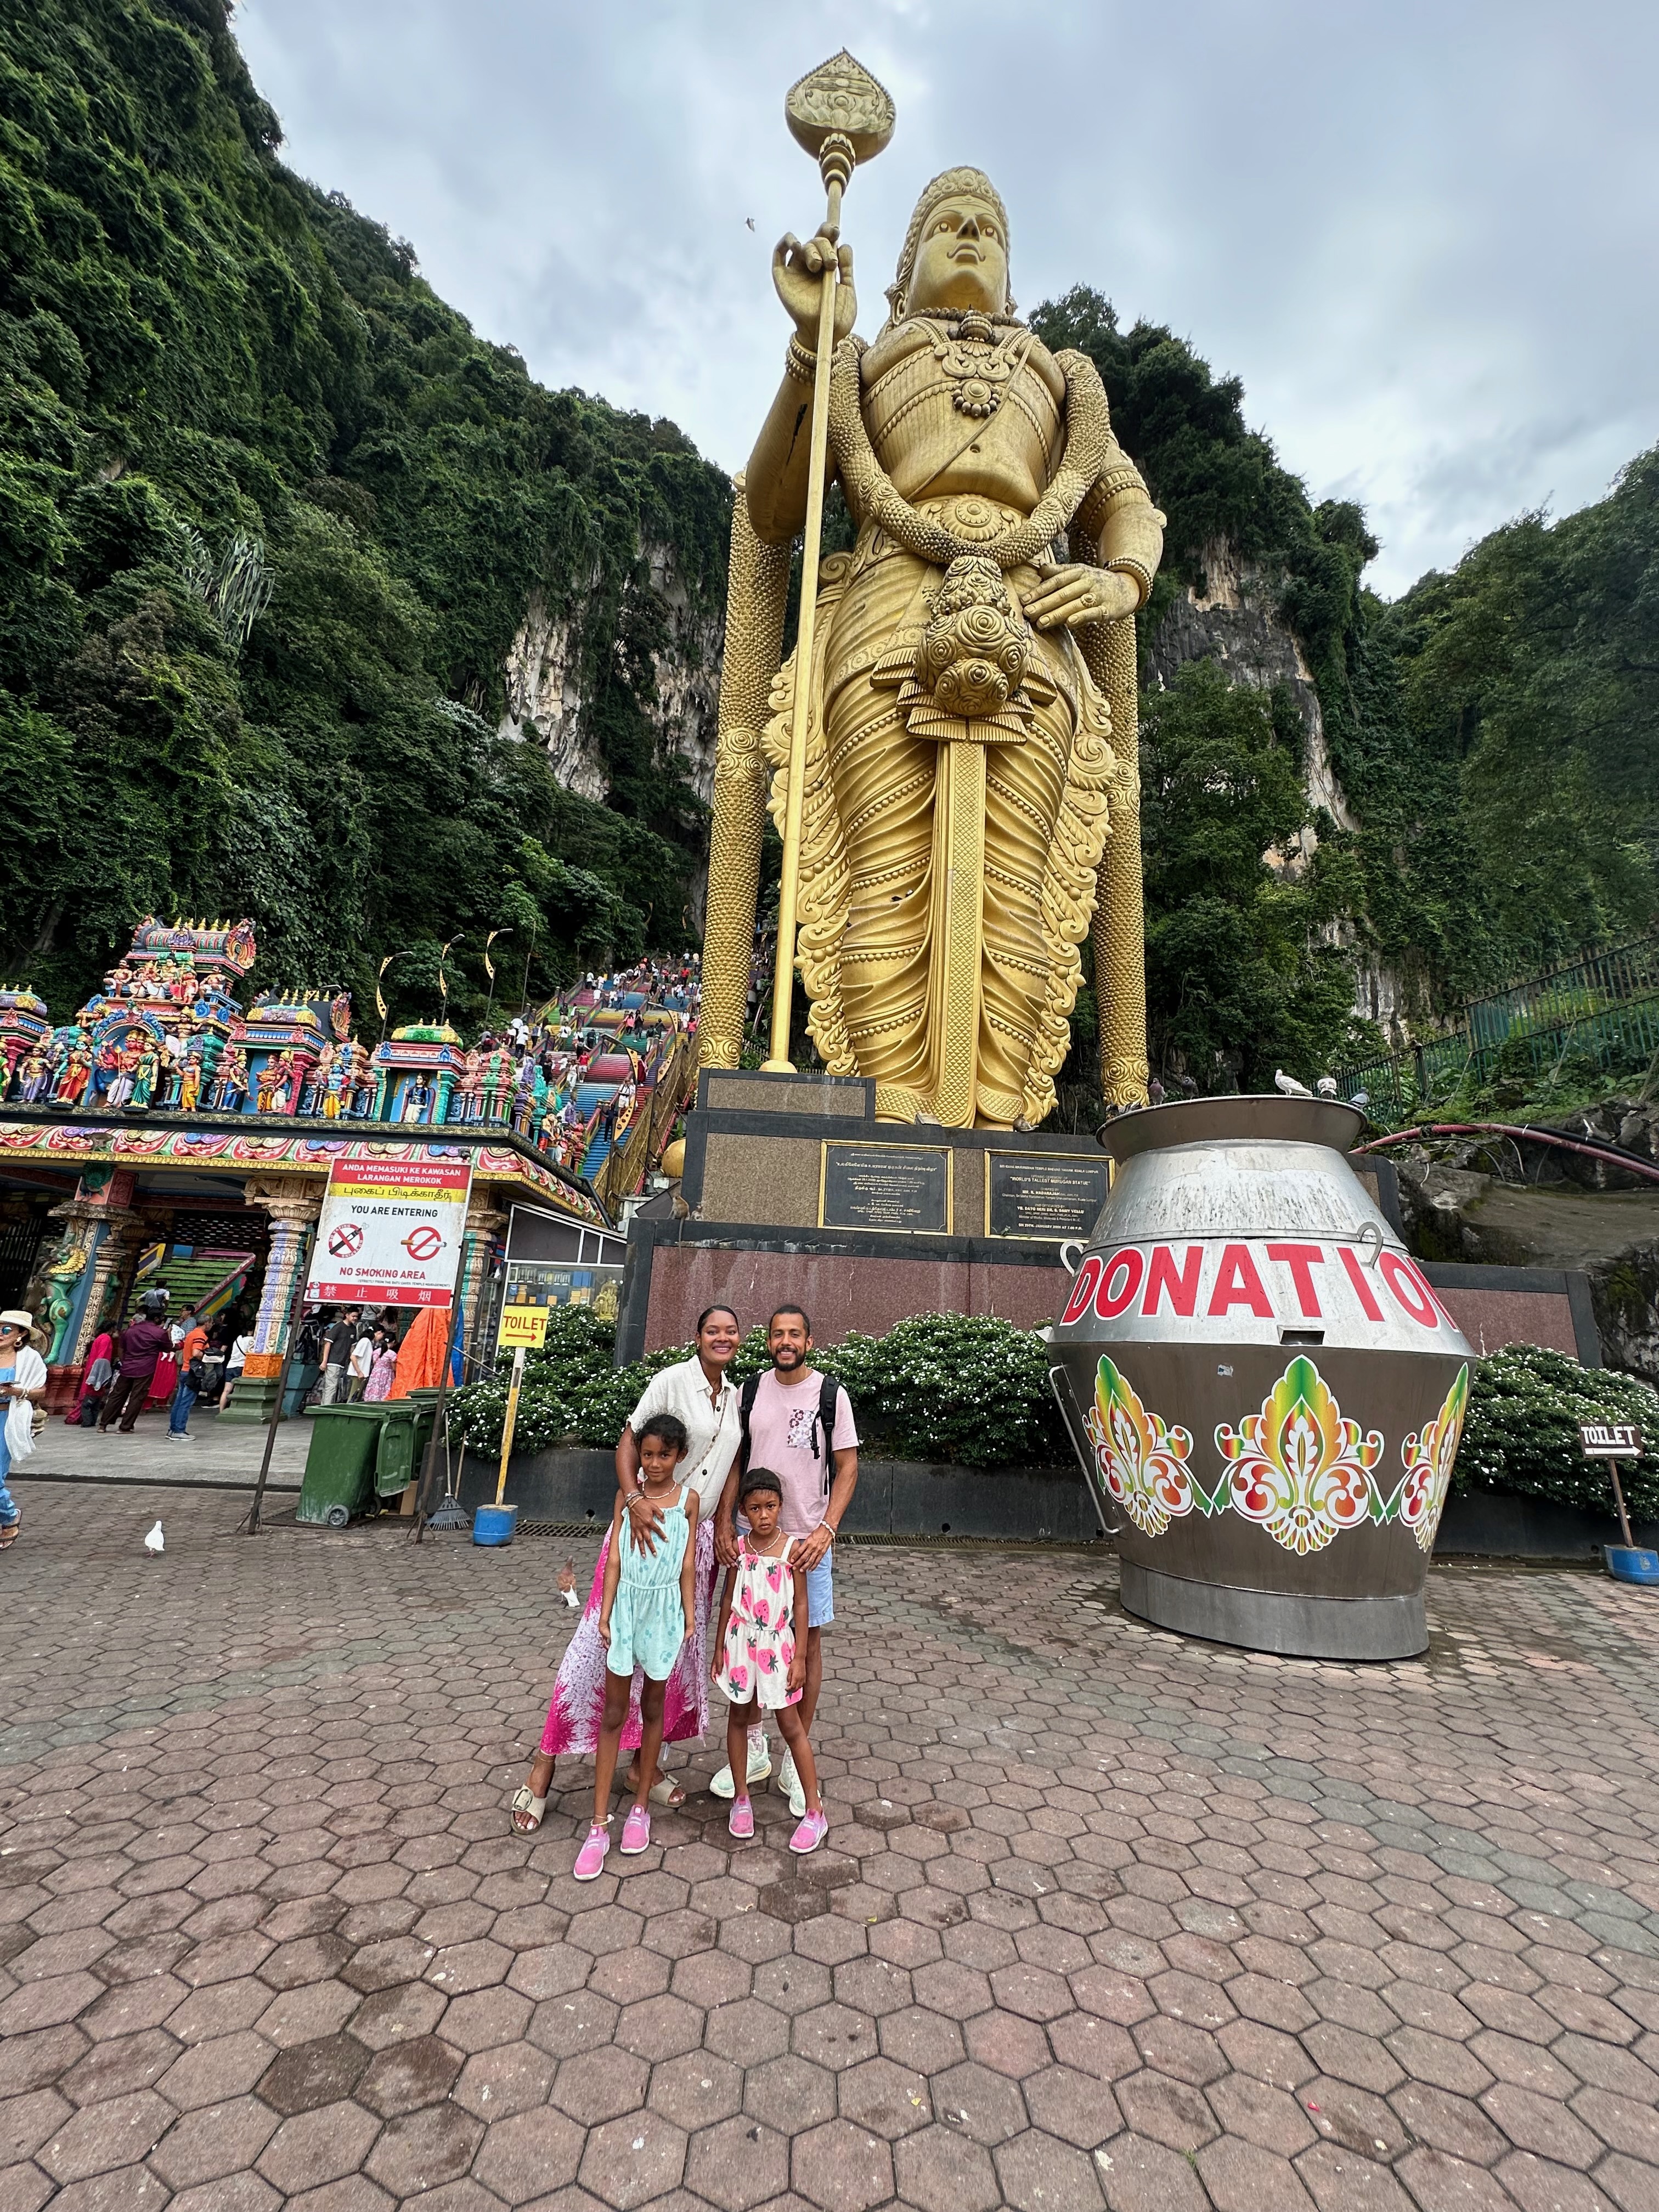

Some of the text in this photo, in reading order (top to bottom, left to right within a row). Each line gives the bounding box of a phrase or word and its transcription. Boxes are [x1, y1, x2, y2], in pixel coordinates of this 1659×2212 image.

[366, 1165, 408, 1173] MEMASUKI
[422, 1167, 461, 1176] KAWASAN
[357, 1173, 442, 1184] LARANGAN MEROKOK
[344, 1186, 384, 1195] புகைப்
[351, 1205, 438, 1217] YOU ARE ENTERING
[340, 1267, 426, 1279] NO SMOKING AREA
[323, 1284, 431, 1302] 禁止吸烟
[1059, 1243, 1462, 1333] DONATIO
[504, 1316, 546, 1331] TOILET
[1581, 1426, 1635, 1445] TOILET
